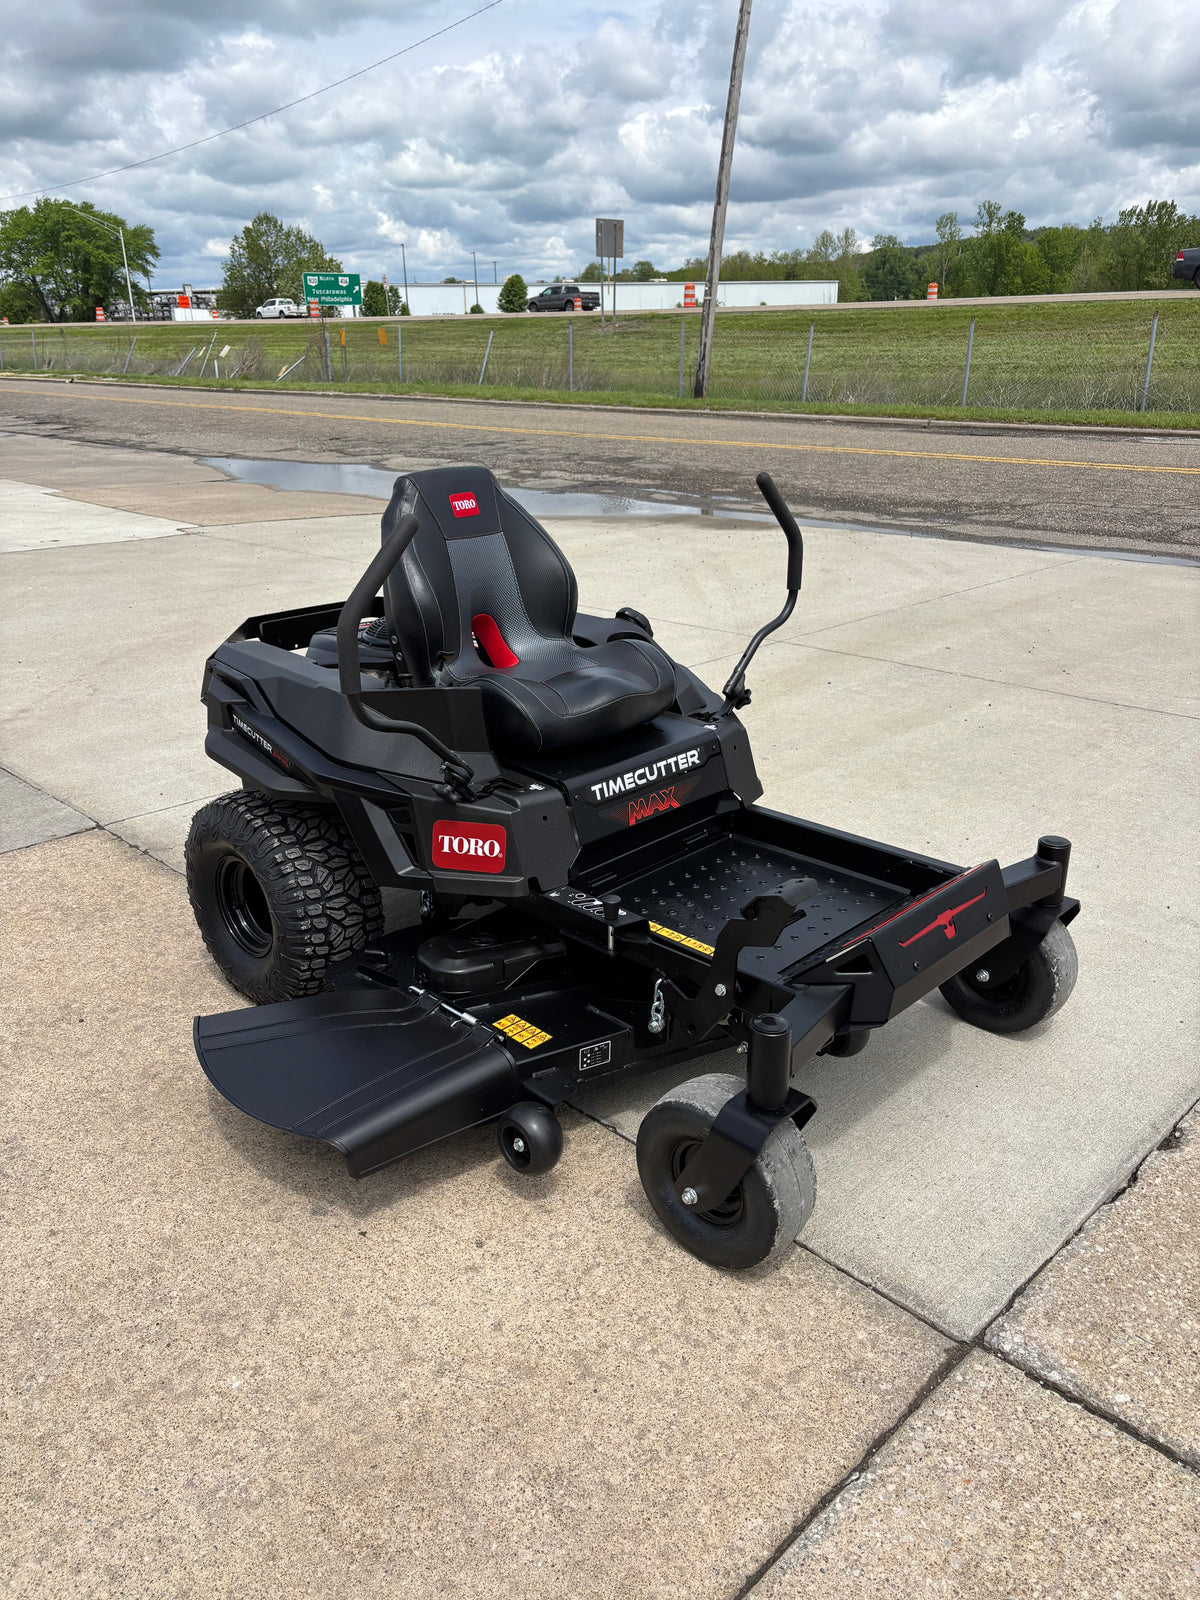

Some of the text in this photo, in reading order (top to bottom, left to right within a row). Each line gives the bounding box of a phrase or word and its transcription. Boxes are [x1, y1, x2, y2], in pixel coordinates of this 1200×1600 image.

[452, 499, 476, 511] TORO
[232, 714, 273, 754] TIMECUTTER
[590, 749, 701, 801] TIMECUTTER
[628, 786, 680, 826] MAX
[438, 834, 501, 858] TORO
